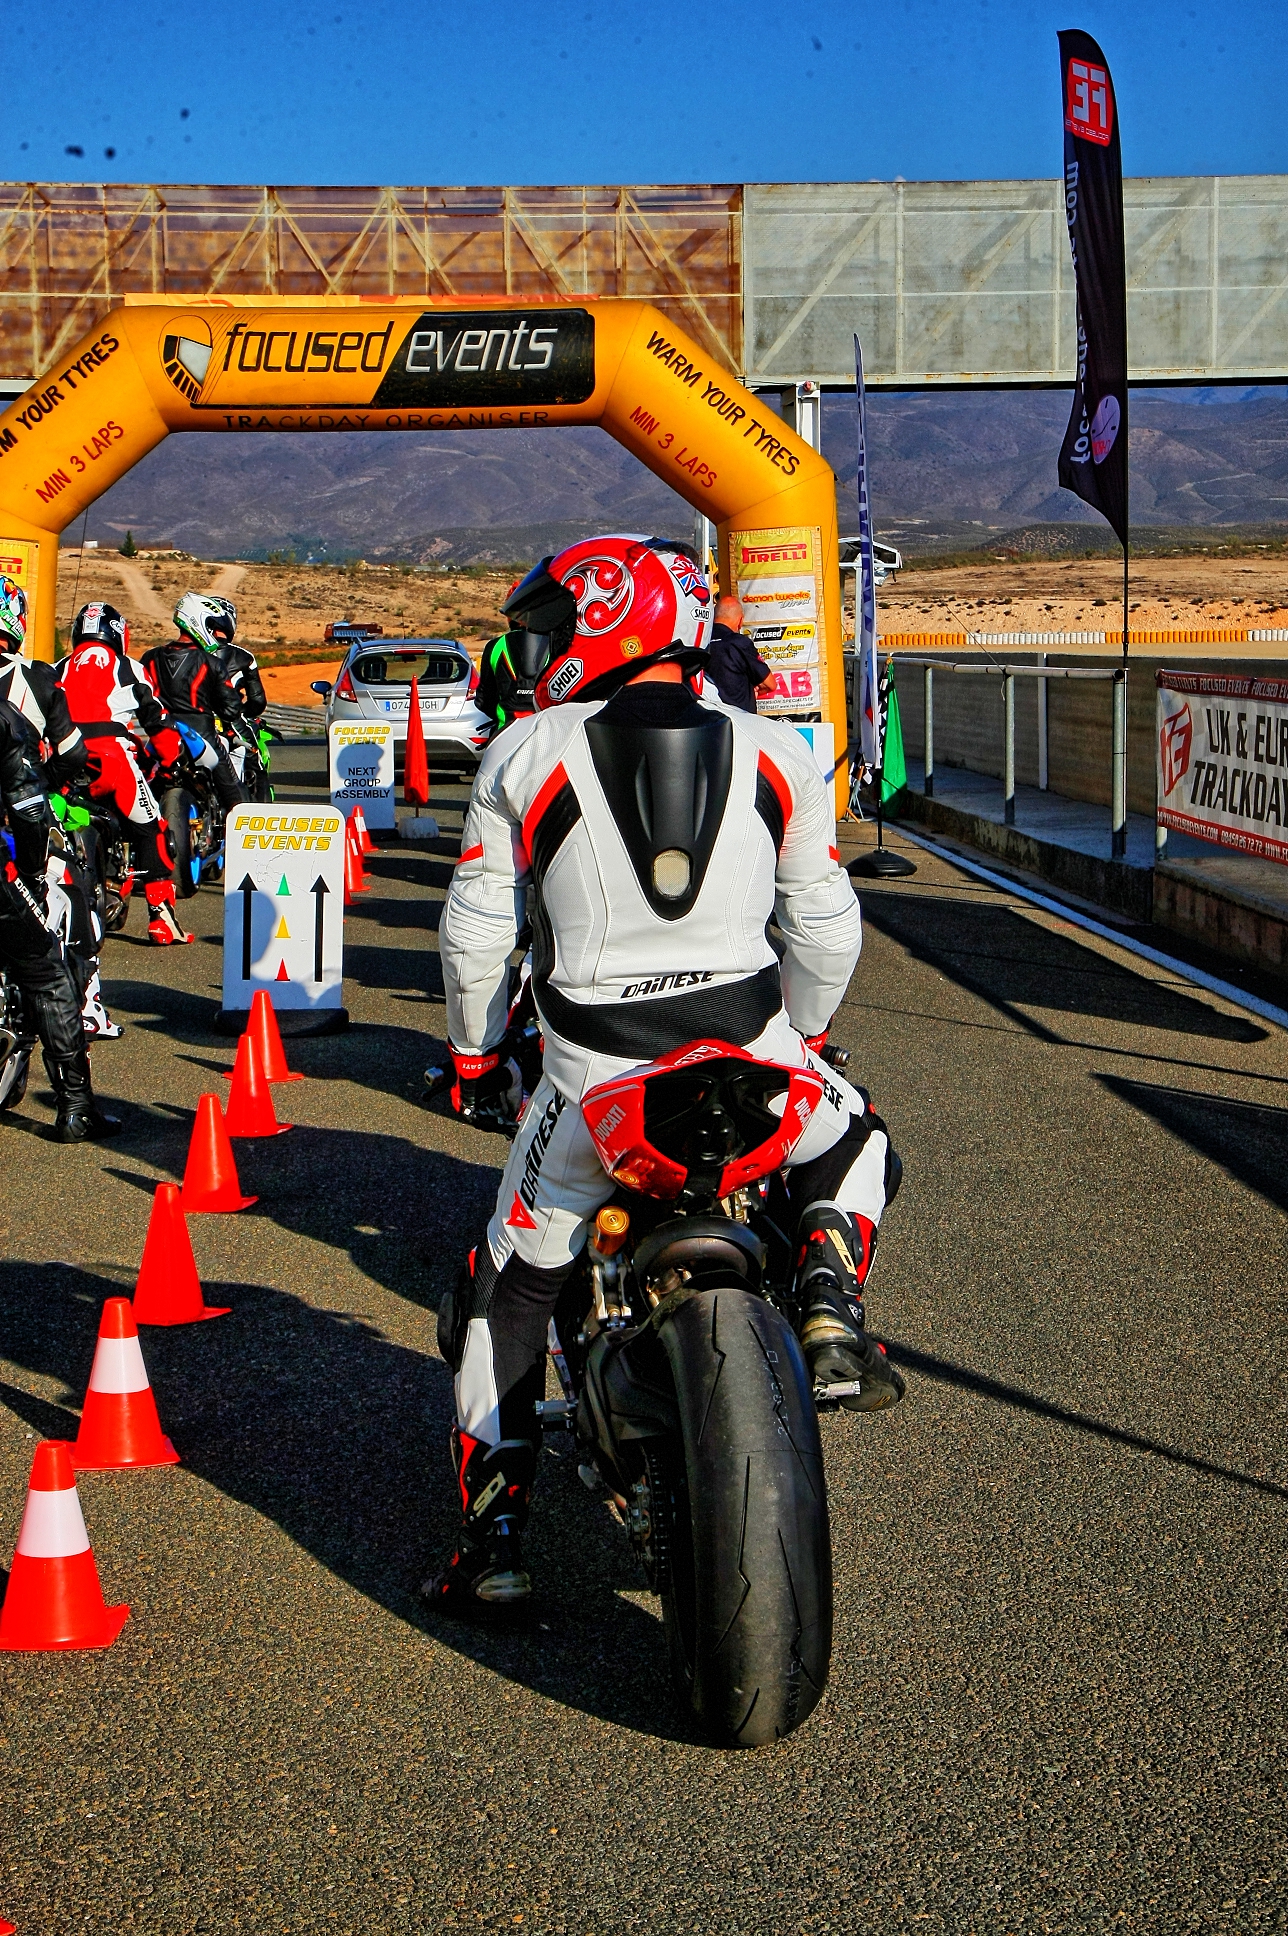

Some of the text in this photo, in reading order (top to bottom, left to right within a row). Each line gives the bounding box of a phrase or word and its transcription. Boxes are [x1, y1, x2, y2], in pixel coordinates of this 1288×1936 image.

[222, 320, 559, 373] focused events
[16, 333, 120, 430] YOUR TYRES
[646, 330, 801, 476] WARM YOUR TYRES
[223, 411, 549, 431] TRACKDAY ORGANISER
[629, 405, 718, 489] MIN 3 LAPS
[35, 420, 124, 504] MIN 3 LAPS
[742, 543, 807, 564] PIRELLI
[551, 662, 580, 697] SHOEI
[391, 701, 410, 710] 074
[334, 726, 391, 735] FOCUSED
[338, 736, 387, 745] EVENTS
[1206, 708, 1288, 769] UK & EUR
[343, 778, 381, 787] GROUP
[348, 767, 376, 776] NEXT
[334, 789, 391, 799] ASSEMBLY
[234, 816, 340, 833] FOCUSED
[242, 835, 332, 851] EVENTS
[620, 971, 714, 999] DAINESE
[593, 1103, 627, 1143] DUCATI
[520, 1083, 566, 1212] DAINESE
